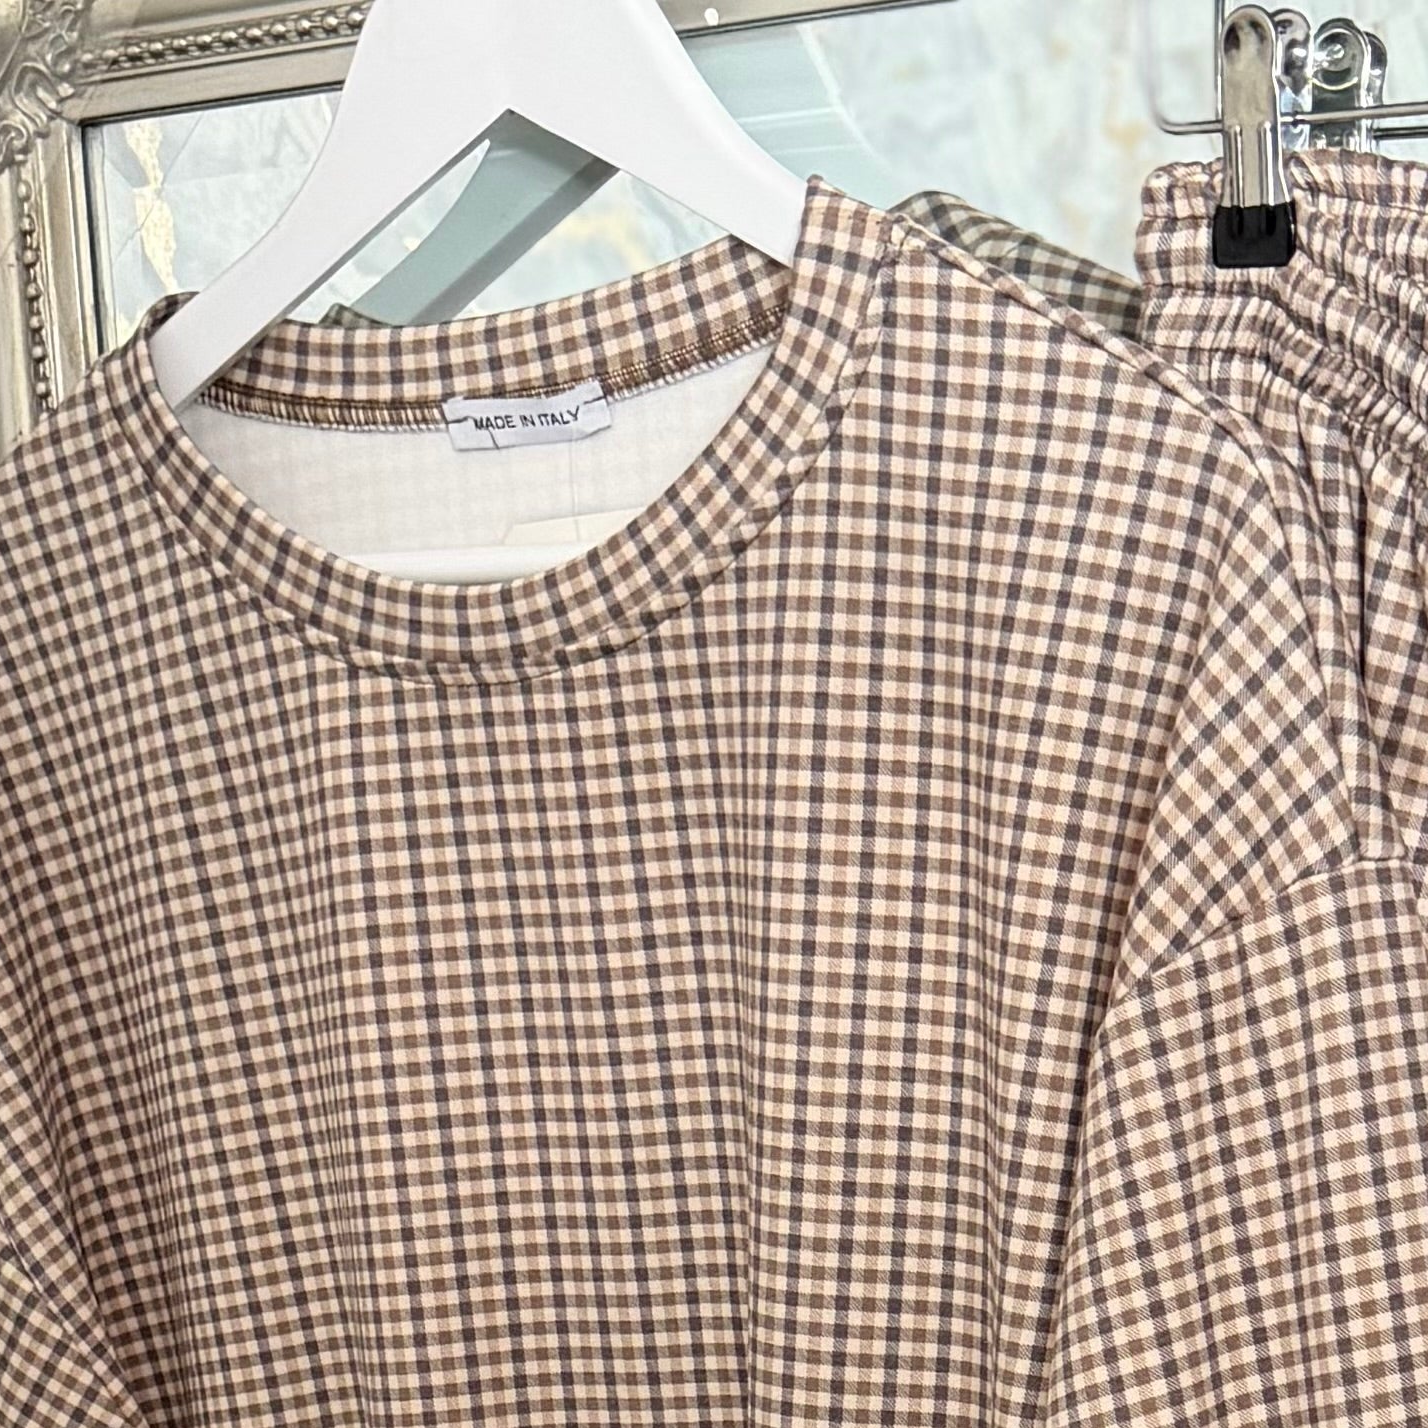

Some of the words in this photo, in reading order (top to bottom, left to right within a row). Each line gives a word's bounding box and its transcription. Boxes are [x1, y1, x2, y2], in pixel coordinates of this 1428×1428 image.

[474, 415, 516, 431] MADE
[520, 415, 536, 427] IN
[538, 405, 580, 427] ITALY
